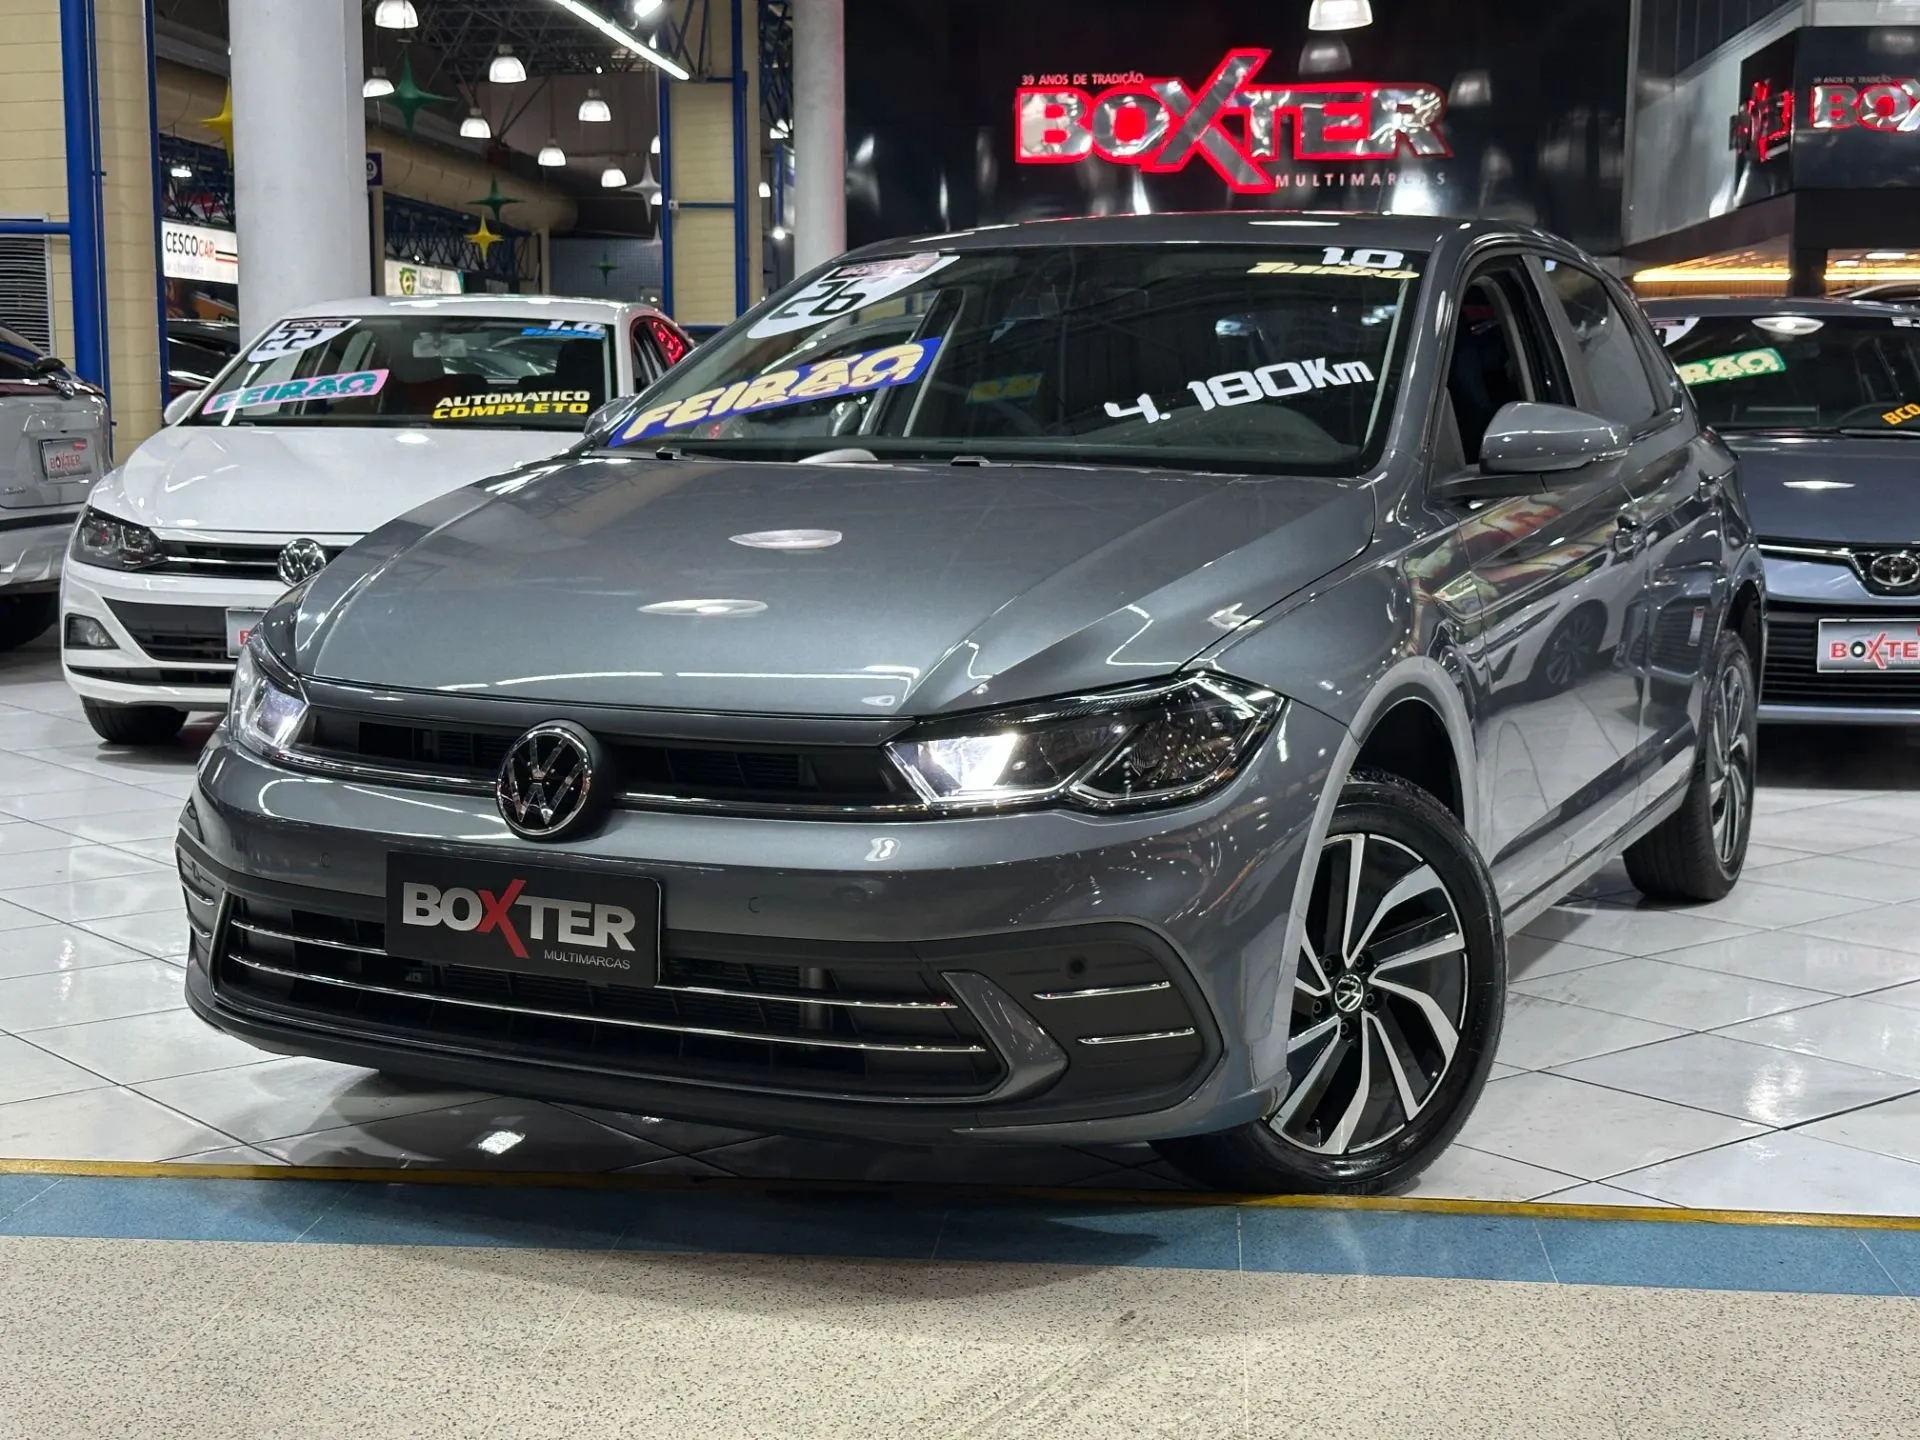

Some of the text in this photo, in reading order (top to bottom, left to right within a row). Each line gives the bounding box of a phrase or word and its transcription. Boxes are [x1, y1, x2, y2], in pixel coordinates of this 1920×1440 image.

[1021, 71, 1145, 86] 39 ANOS DE TRADIÇÃO
[1015, 47, 1454, 194] BOXTER
[165, 231, 215, 259] CESCOCAR
[1322, 247, 1405, 269] 1.0
[256, 328, 323, 351] 22
[211, 373, 378, 411] FEIRÃO
[436, 390, 591, 409] AUTOMATICO
[622, 344, 925, 440] FEIRÃO
[432, 402, 589, 420] COMPLETO
[1829, 632, 1920, 670] BOXTE
[402, 878, 637, 960] BOXTER
[543, 949, 631, 970] MULTIMARCAS
